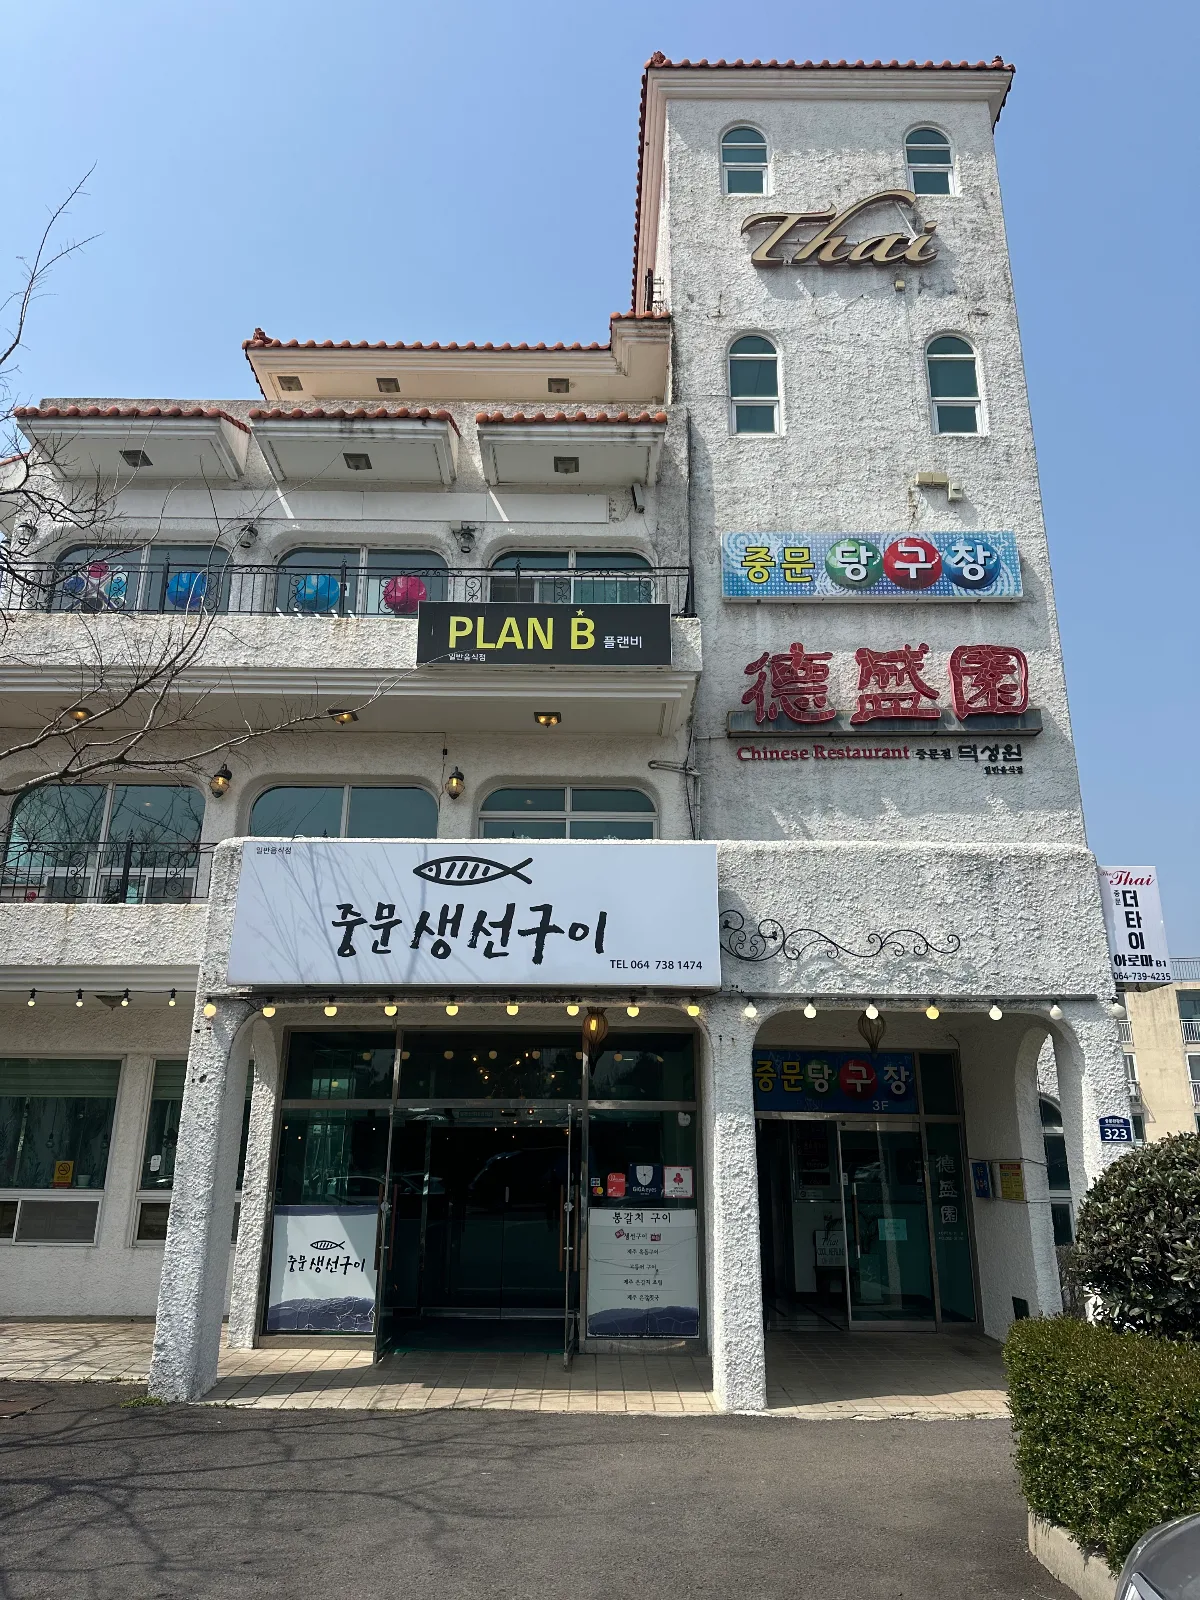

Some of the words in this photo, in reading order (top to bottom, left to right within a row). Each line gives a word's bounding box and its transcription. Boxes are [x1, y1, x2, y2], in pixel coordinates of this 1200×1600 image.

[741, 189, 939, 268] Thai
[449, 616, 553, 649] PLAN
[570, 617, 596, 649] B
[603, 635, 643, 649] 플랜비
[449, 651, 486, 662] 일반음식점
[737, 746, 809, 760] Chinese
[813, 744, 910, 760] Restaurant
[958, 743, 1023, 762] 덕성원
[256, 846, 292, 855] 일반음식점
[1109, 870, 1155, 885] Thai
[610, 959, 628, 969] TEL
[630, 960, 650, 970] 064
[655, 960, 675, 970] 738
[677, 960, 703, 970] 1474
[1114, 954, 1154, 967] 아로마
[1156, 959, 1167, 967] B1
[1113, 971, 1171, 981] 064-739-4235
[872, 1100, 889, 1111] 3F
[1104, 1128, 1128, 1140] 323
[650, 1212, 671, 1224] 구이
